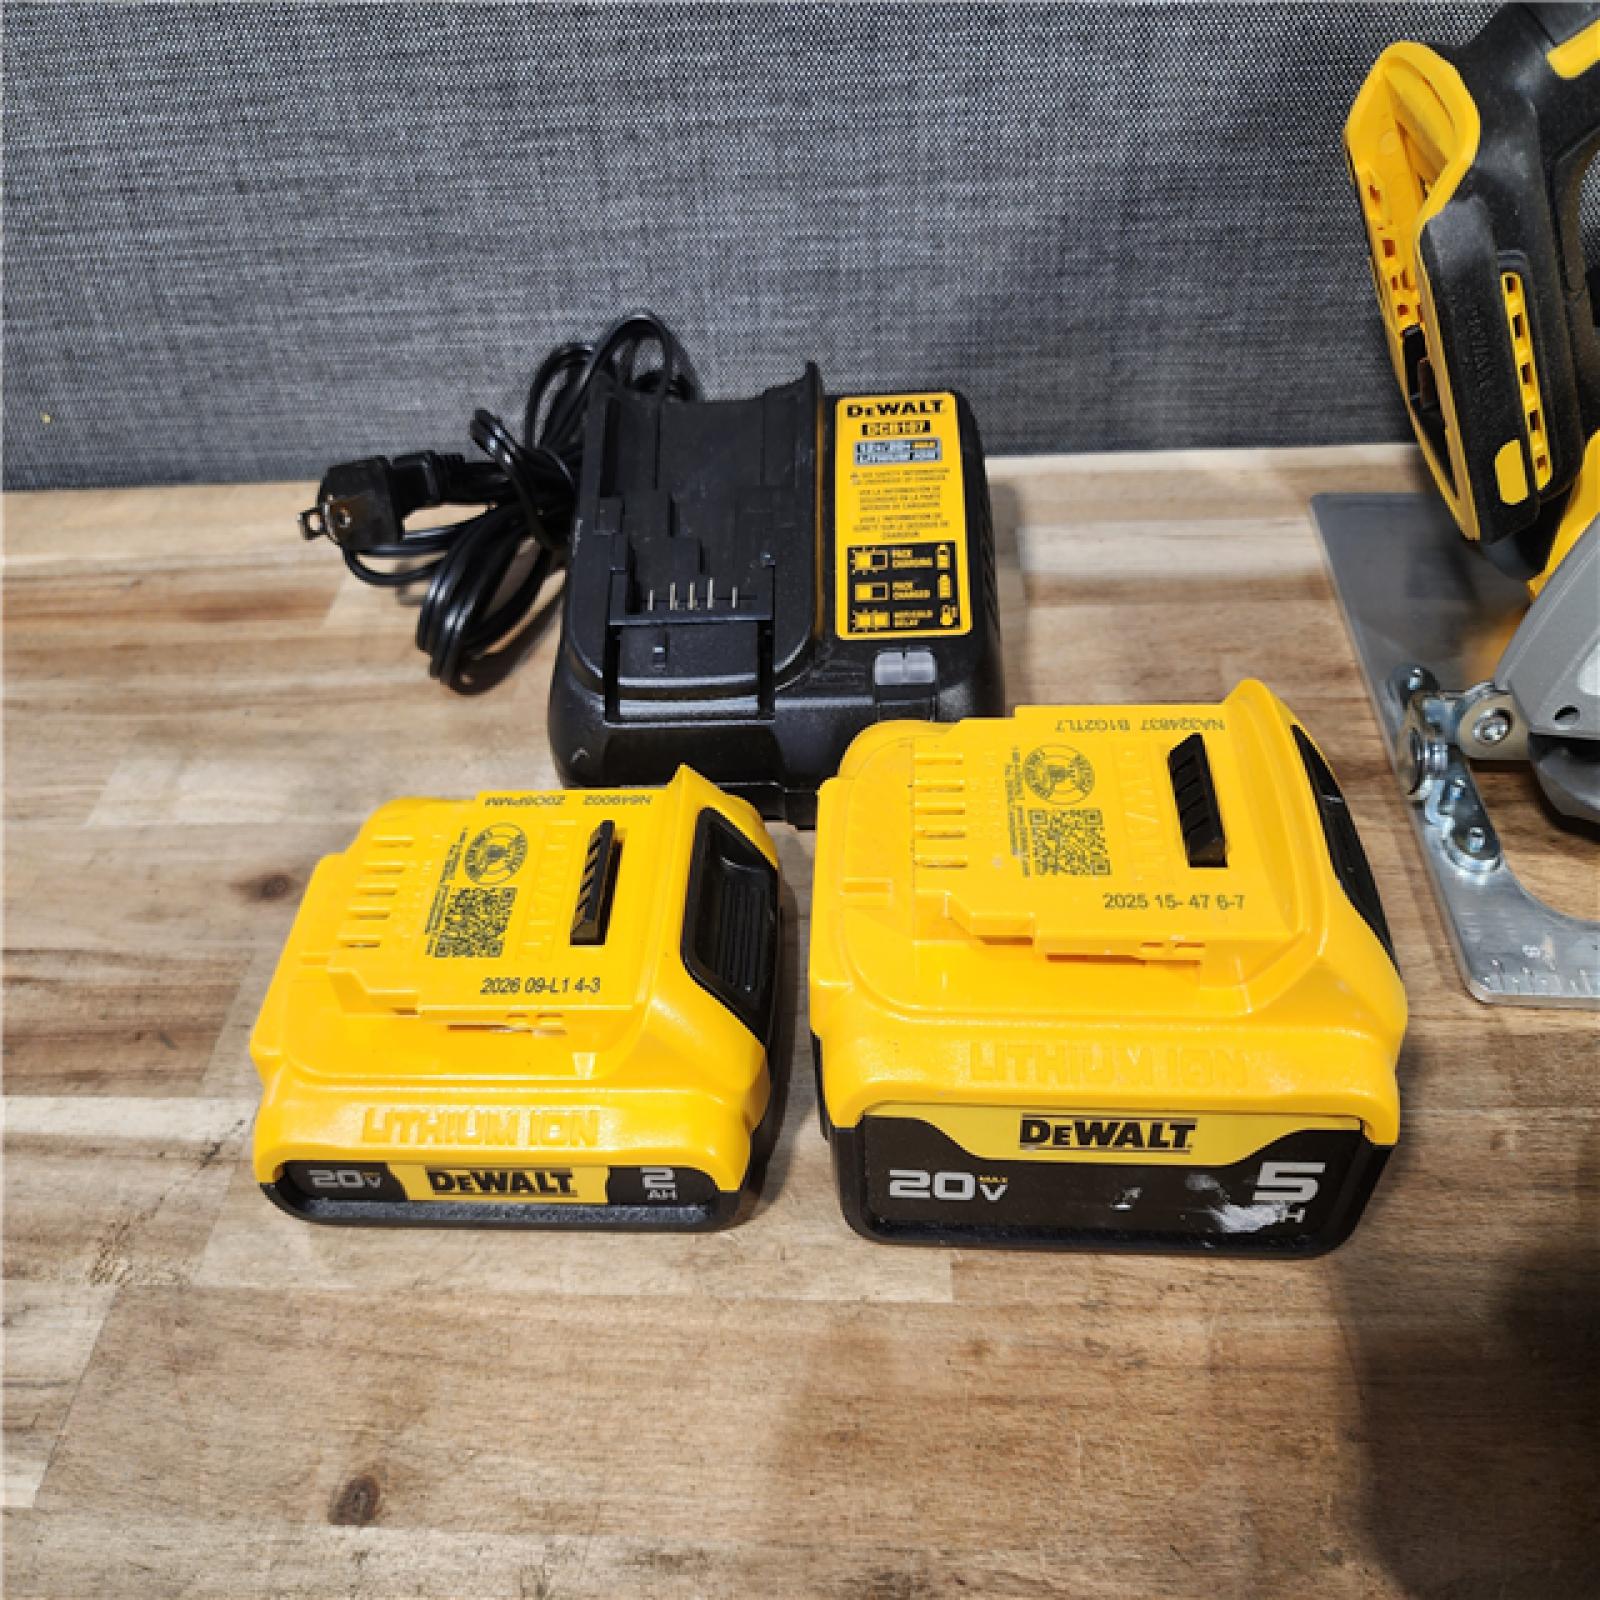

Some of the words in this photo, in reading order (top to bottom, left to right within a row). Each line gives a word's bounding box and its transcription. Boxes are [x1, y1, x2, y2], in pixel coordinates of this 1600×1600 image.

[847, 399, 942, 417] DEWALT
[1103, 892, 1149, 910] 2025
[970, 1041, 1153, 1087] LITHIUM
[1162, 1046, 1249, 1090] ION
[362, 1106, 518, 1146] LITHIUM
[529, 1109, 599, 1147] ION
[1019, 1118, 1197, 1149] DEWALT
[427, 1169, 574, 1195] DEWALT
[640, 1167, 676, 1189] 2
[1252, 1161, 1326, 1203] 5
